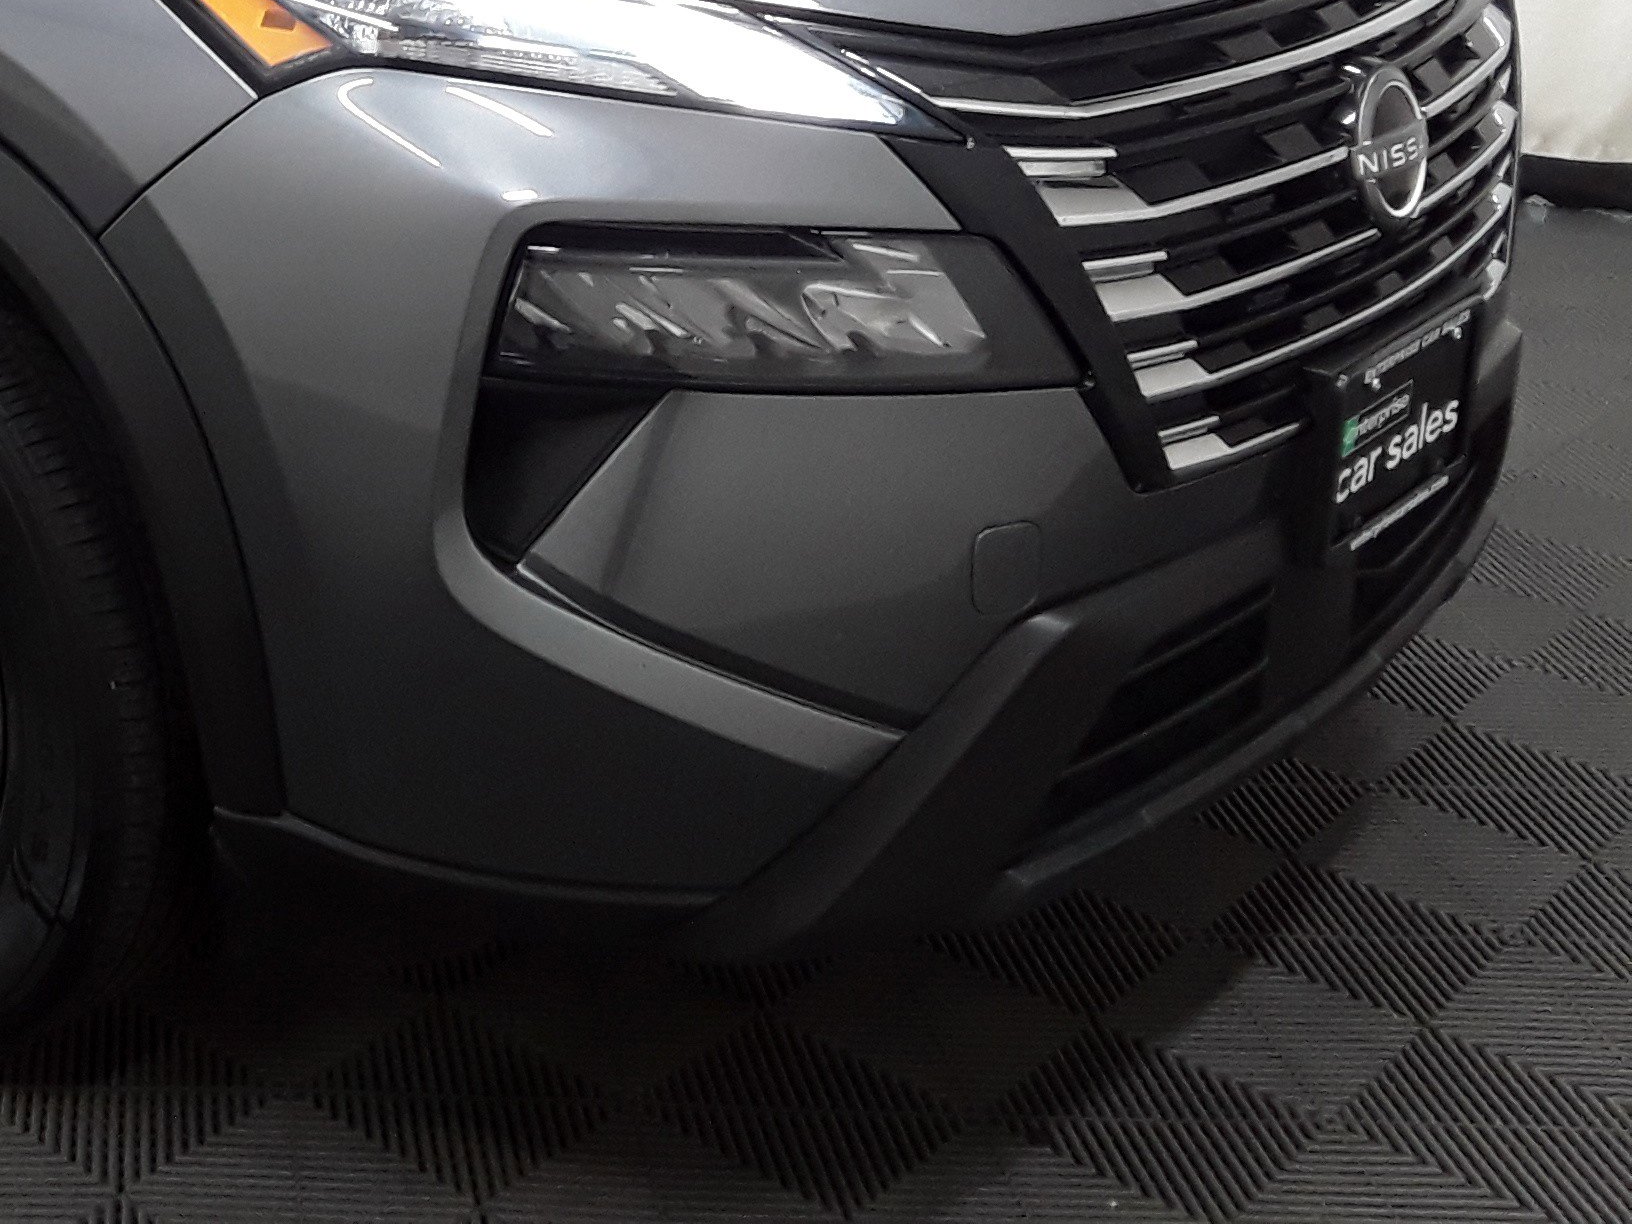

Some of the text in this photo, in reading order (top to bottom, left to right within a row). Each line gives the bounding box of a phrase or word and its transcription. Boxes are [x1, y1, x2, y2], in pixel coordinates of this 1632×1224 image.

[1357, 137, 1420, 176] NISS
[1334, 399, 1460, 504] car sales
